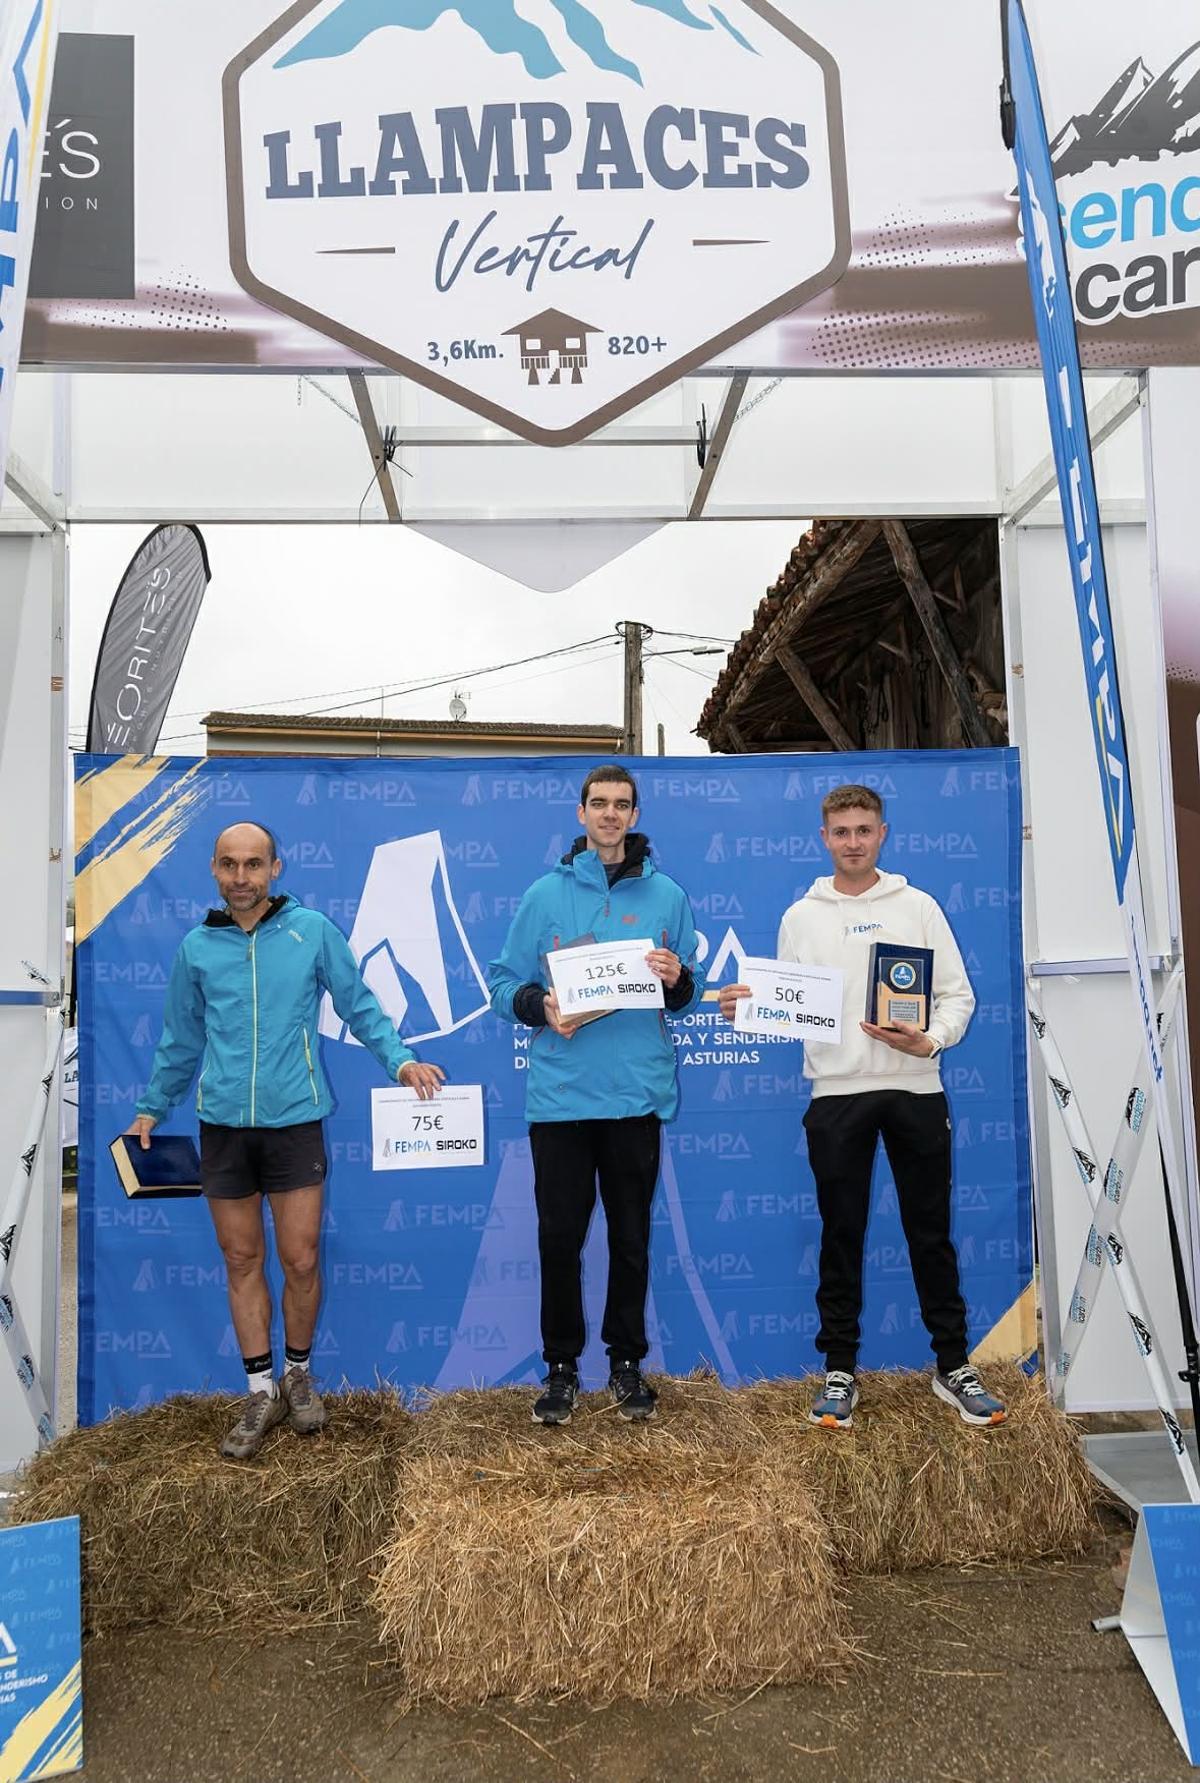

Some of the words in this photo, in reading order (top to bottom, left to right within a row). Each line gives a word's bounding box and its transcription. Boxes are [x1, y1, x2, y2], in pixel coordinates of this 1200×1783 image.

[263, 101, 810, 199] LLAMPACES
[45, 196, 98, 210] ION
[435, 210, 655, 292] Vertical
[1076, 247, 1200, 320] car
[427, 341, 504, 361] 3,6Km.
[608, 335, 667, 355] 820+
[327, 780, 417, 800] FEMPA
[491, 778, 578, 799] FEMPA
[653, 777, 740, 797] FEMPA
[735, 836, 822, 857] FEMPA
[895, 833, 978, 852] FEMPA
[853, 922, 884, 934] FEMPA
[585, 962, 628, 980] 125€
[578, 984, 614, 999] FEMPA
[617, 983, 656, 994] SIROKO
[774, 987, 805, 1005] 50€
[757, 1007, 791, 1023] FEMPA
[795, 1013, 836, 1029] SIROKO
[698, 1033, 708, 1046] Y
[682, 1051, 760, 1066] ASTURIAS
[411, 1115, 444, 1131] 75€
[395, 1139, 431, 1153] FEMPA
[436, 1138, 477, 1151] SIROKO
[666, 1133, 750, 1154] FEMPA
[415, 1203, 502, 1226] FEMPA
[332, 1263, 423, 1285] FEMPA
[665, 1253, 752, 1275] FEMPA
[418, 1325, 506, 1346] FEMPA
